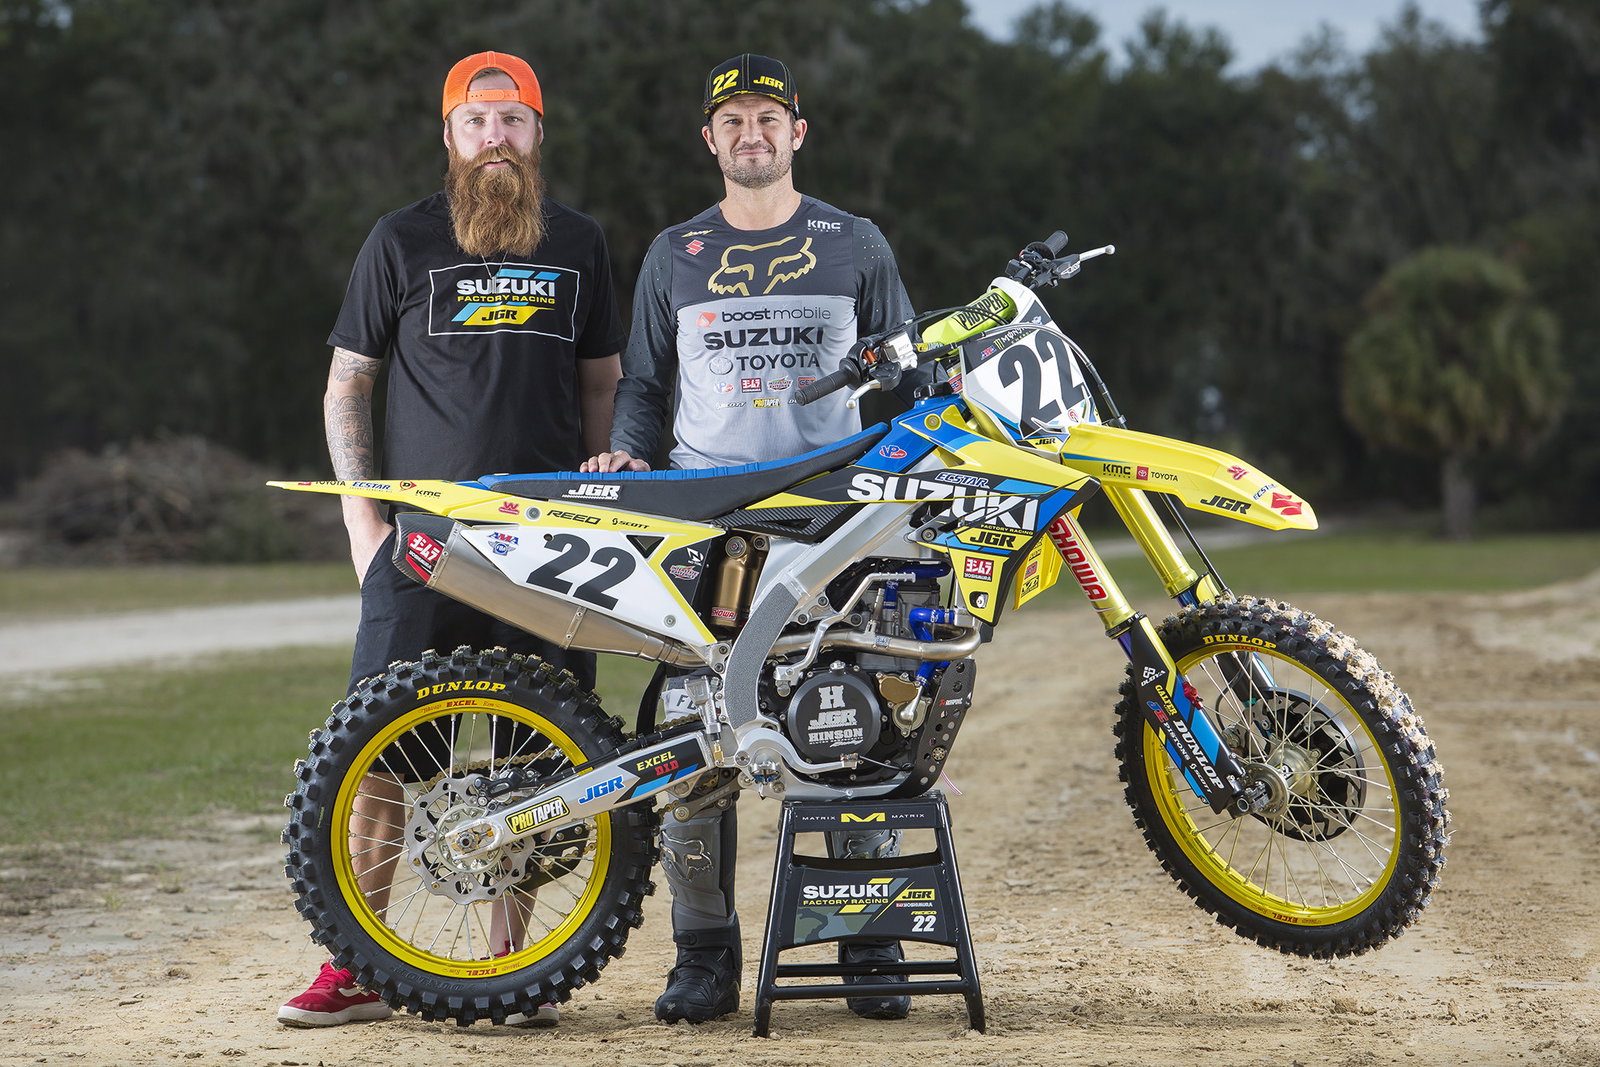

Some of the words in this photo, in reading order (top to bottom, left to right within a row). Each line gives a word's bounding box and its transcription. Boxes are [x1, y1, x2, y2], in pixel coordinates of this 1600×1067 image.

[713, 69, 739, 97] 22
[753, 76, 784, 91] JGR
[456, 278, 555, 297] SUZUKI
[512, 295, 555, 304] RACING
[481, 309, 517, 321] JGR
[722, 308, 771, 322] boost
[773, 306, 831, 320] mobile
[703, 327, 824, 350] SUZUKI
[736, 352, 820, 371] TOYOTA
[998, 330, 1086, 438] 22
[1035, 438, 1056, 446] JGR
[1103, 463, 1131, 476] KMC
[1151, 472, 1178, 482] TOYOTA
[352, 481, 391, 490] ECSTAR
[935, 471, 990, 489] ECSTAR
[568, 484, 620, 498] JGR
[847, 473, 1039, 531] SUZUKI
[1200, 495, 1252, 514] JGR
[547, 510, 601, 525] REED
[619, 520, 649, 529] SCOTT
[487, 532, 519, 545] AMA
[980, 524, 1008, 532] FACTORY
[1010, 528, 1034, 536] RACING
[410, 534, 441, 561] ヨシムラ
[969, 531, 1016, 549] JGR
[965, 557, 993, 576] ヨシムラ
[1048, 517, 1108, 602] SHOWA
[526, 533, 637, 611] 22
[1203, 634, 1277, 649] DUNLOP
[416, 680, 507, 700] DUNLOP
[818, 685, 845, 709] H
[446, 700, 478, 708] EXCEL
[1155, 684, 1178, 715] GALFER
[808, 728, 863, 742] HINSON
[1163, 721, 1191, 761] PISTONS
[636, 751, 676, 771] EXCEL
[1173, 719, 1225, 790] DUNLOP
[578, 775, 626, 804] JGR
[511, 802, 565, 832] PROTAPER
[803, 884, 889, 899] SUZUKI
[902, 891, 932, 899] JGR
[911, 915, 937, 932] 22
[1272, 912, 1298, 924] EXCEL
[466, 968, 497, 976] EXCEL
